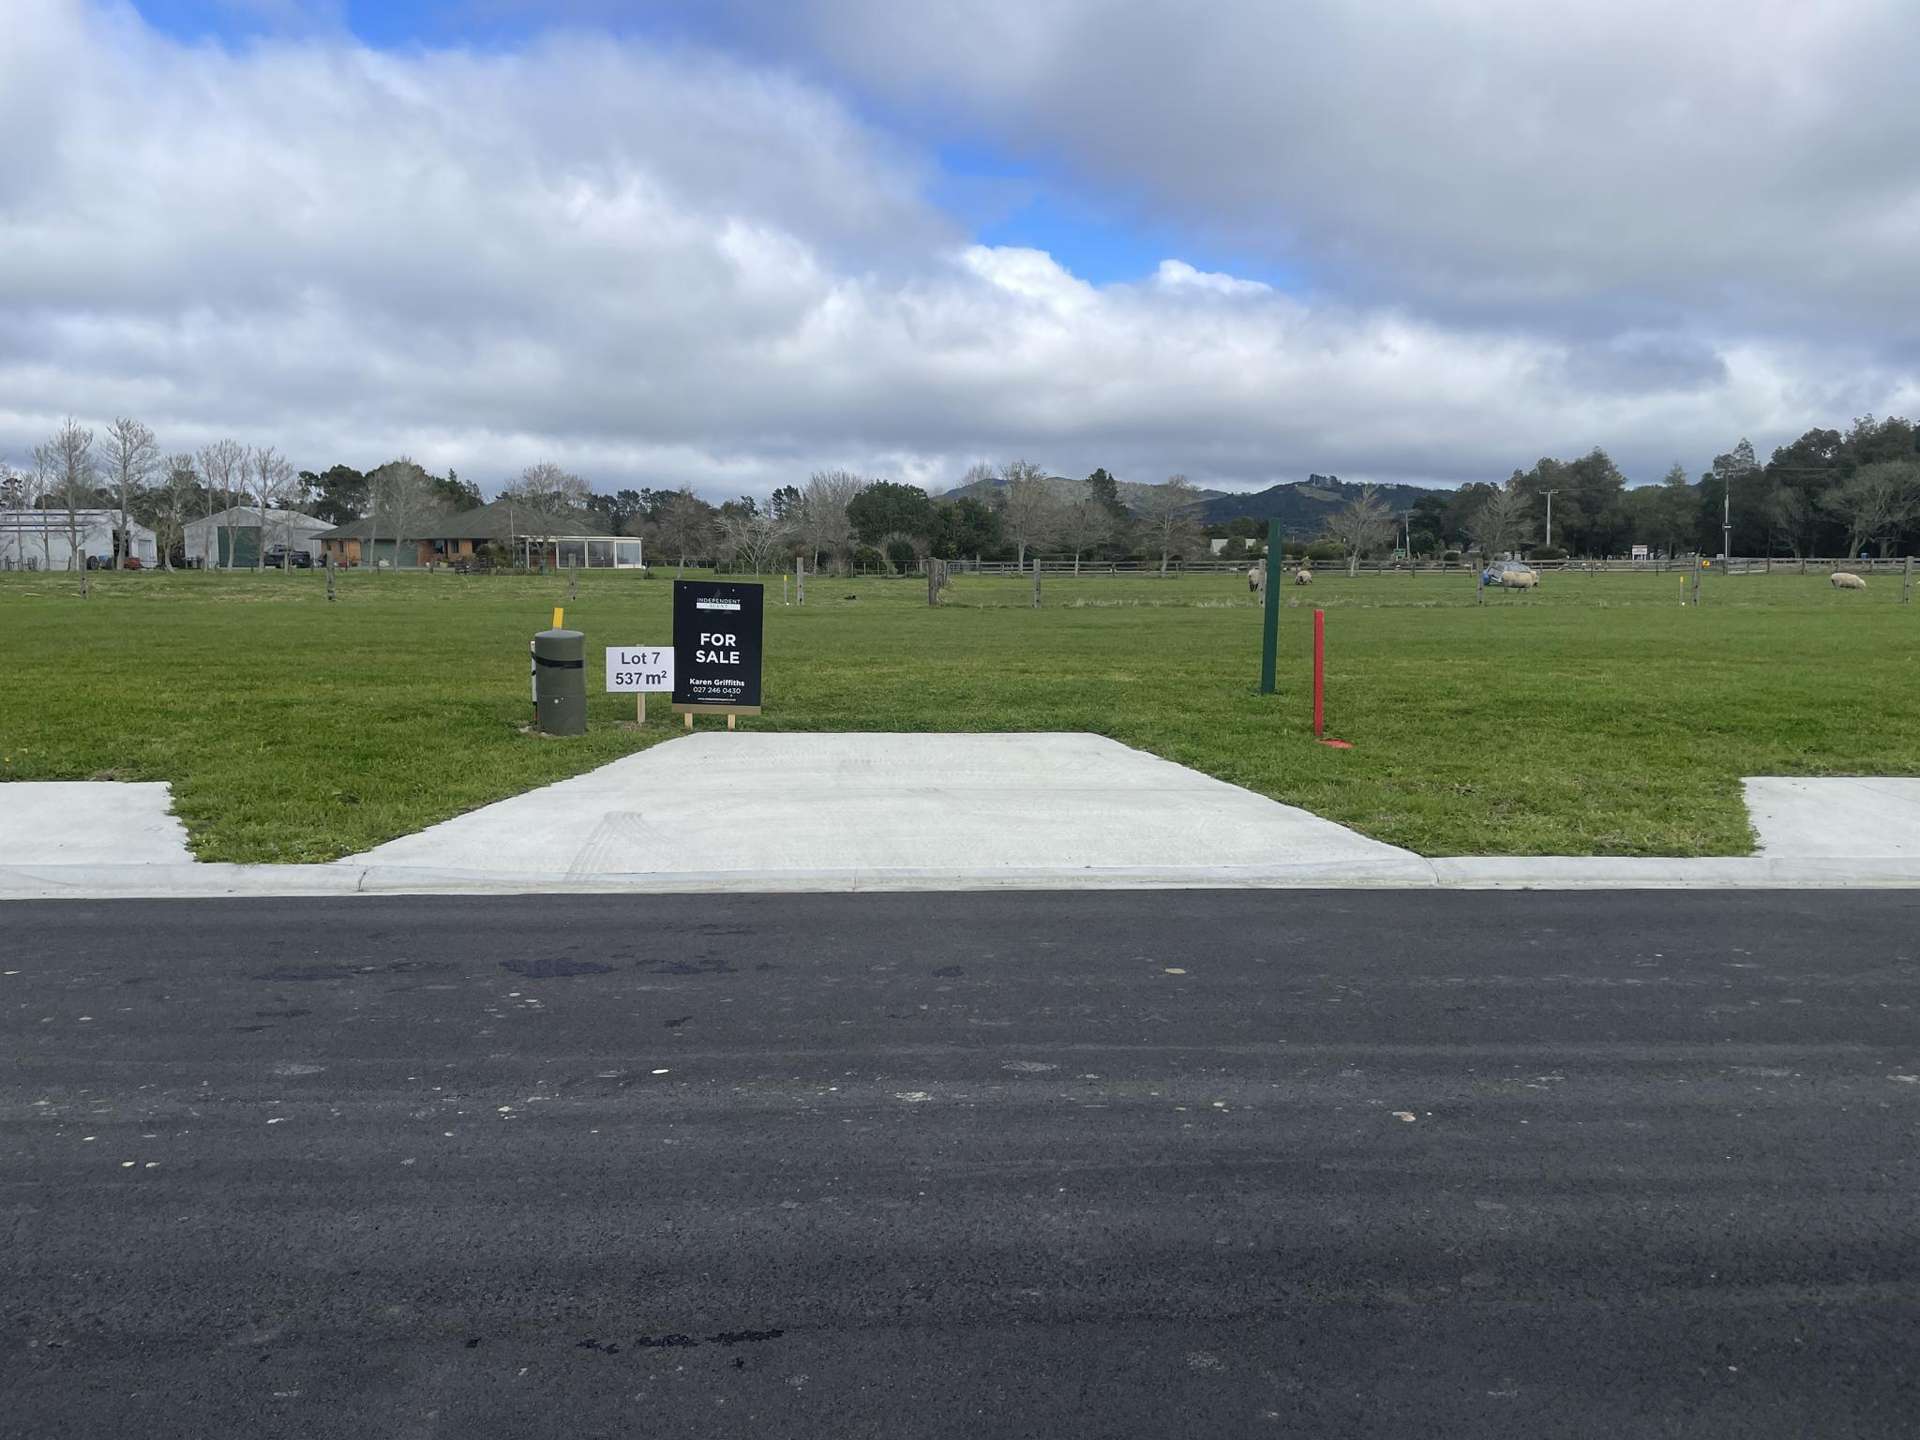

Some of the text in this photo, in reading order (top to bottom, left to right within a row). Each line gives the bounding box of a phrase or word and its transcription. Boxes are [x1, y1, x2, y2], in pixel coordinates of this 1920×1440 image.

[701, 633, 736, 646] FOR
[621, 652, 660, 664] Lot 7
[696, 650, 740, 664] SALE
[616, 672, 642, 685] 537
[689, 678, 745, 687] Karen Griffiths
